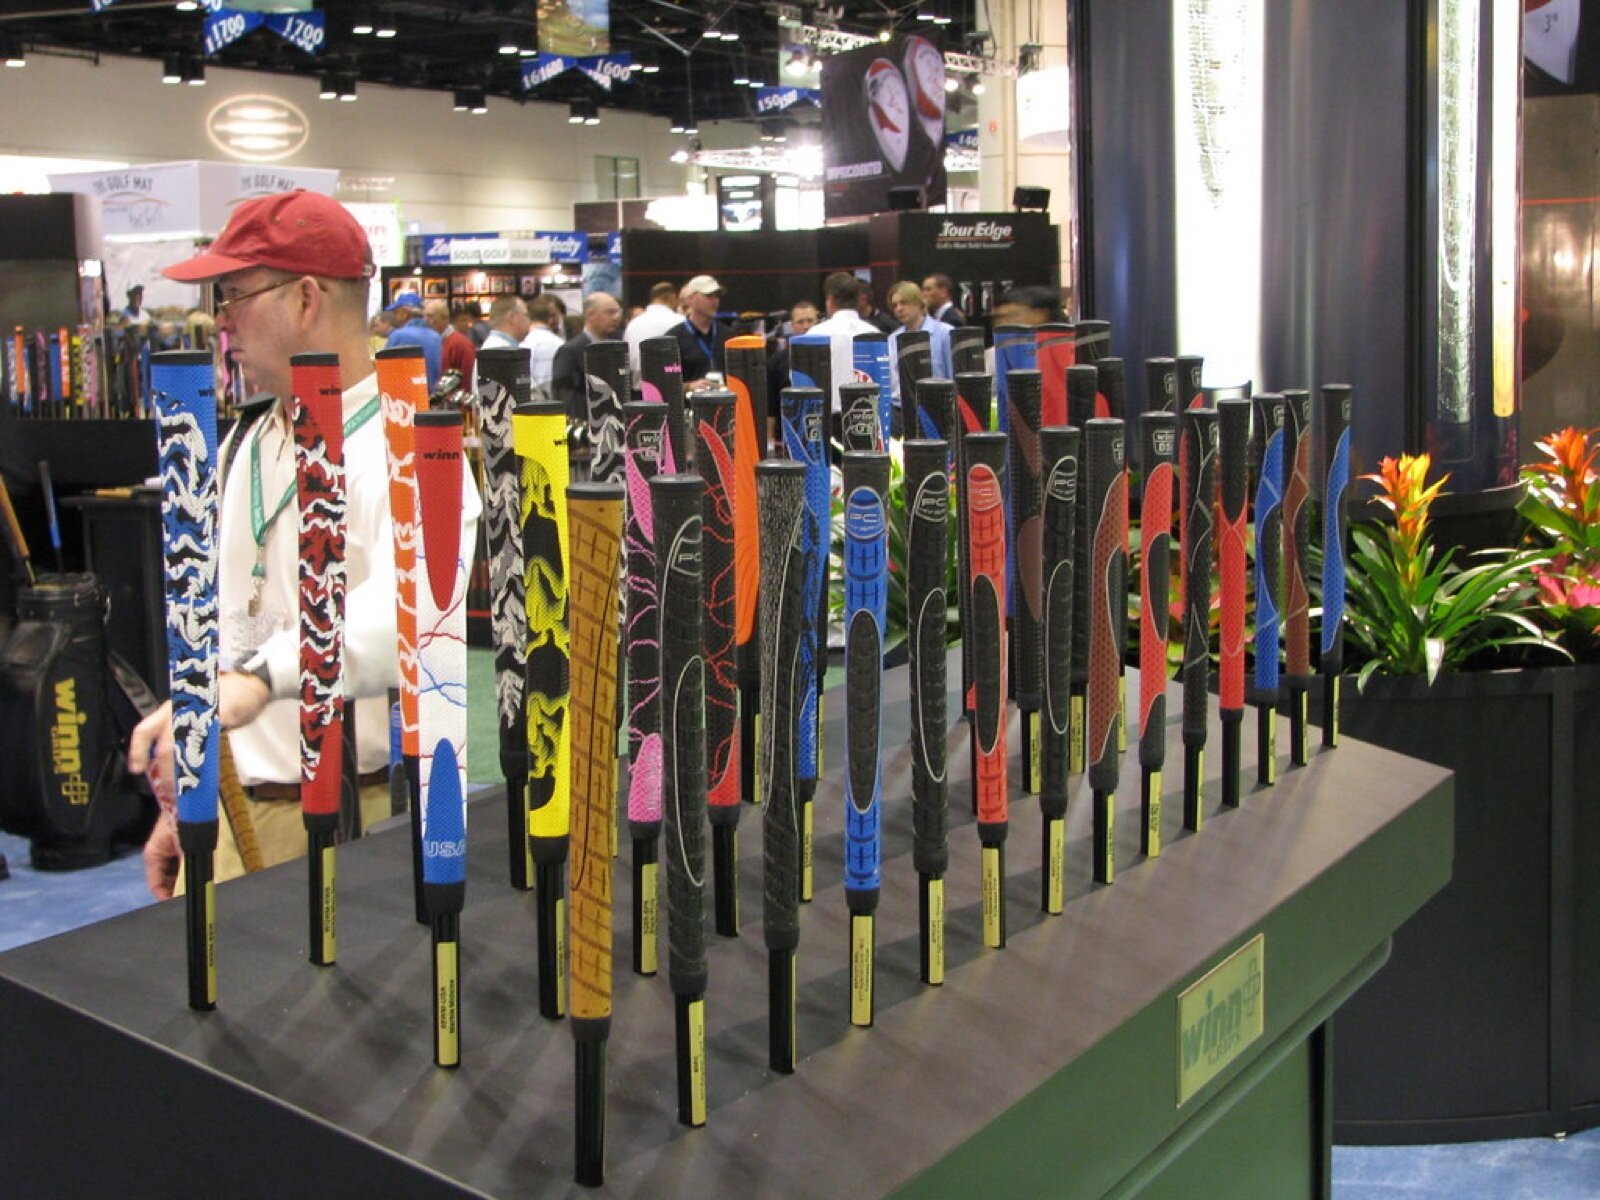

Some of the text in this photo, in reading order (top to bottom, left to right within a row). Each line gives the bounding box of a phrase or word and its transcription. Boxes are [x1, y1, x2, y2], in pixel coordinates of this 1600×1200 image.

[939, 220, 1012, 241] Tour Edge
[423, 447, 460, 460] winn
[55, 677, 87, 774] winn
